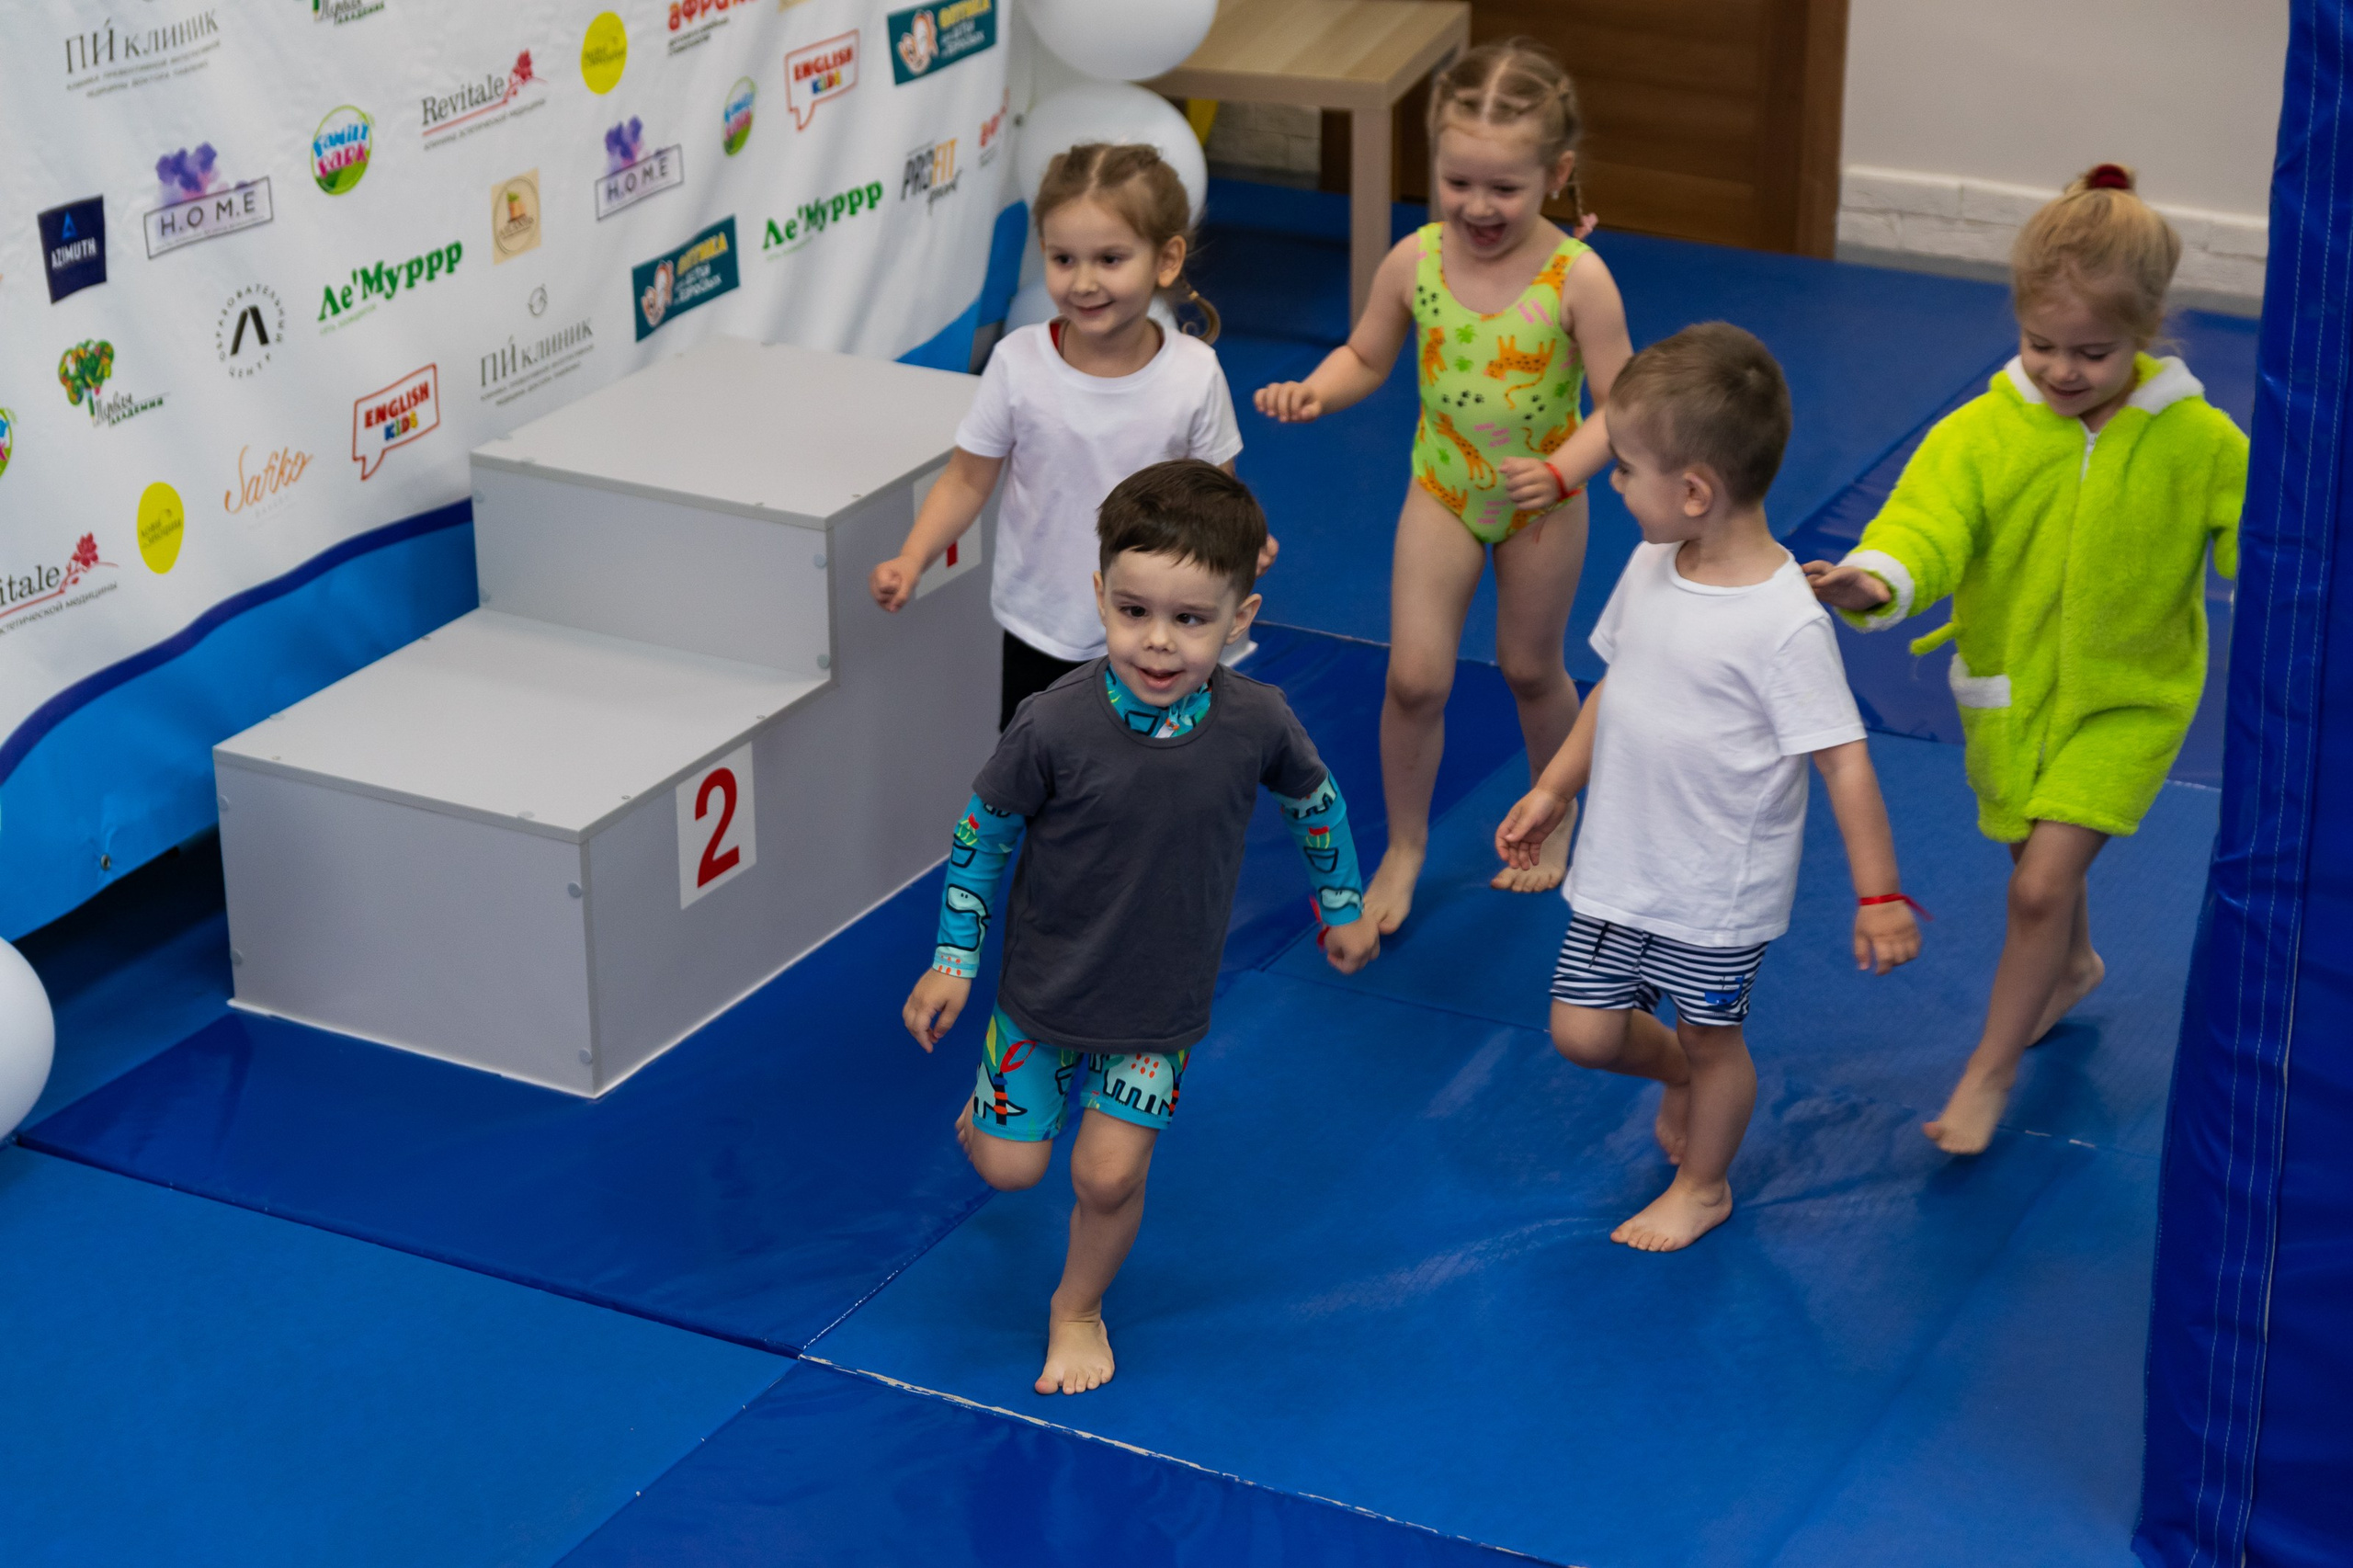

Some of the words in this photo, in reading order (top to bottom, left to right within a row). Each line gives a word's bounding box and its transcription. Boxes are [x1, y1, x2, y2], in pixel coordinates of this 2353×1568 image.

[422, 74, 506, 126] Revitale
[51, 236, 97, 270] AZIMUTH
[365, 380, 429, 429] ENGLISH
[695, 767, 740, 889] 2
